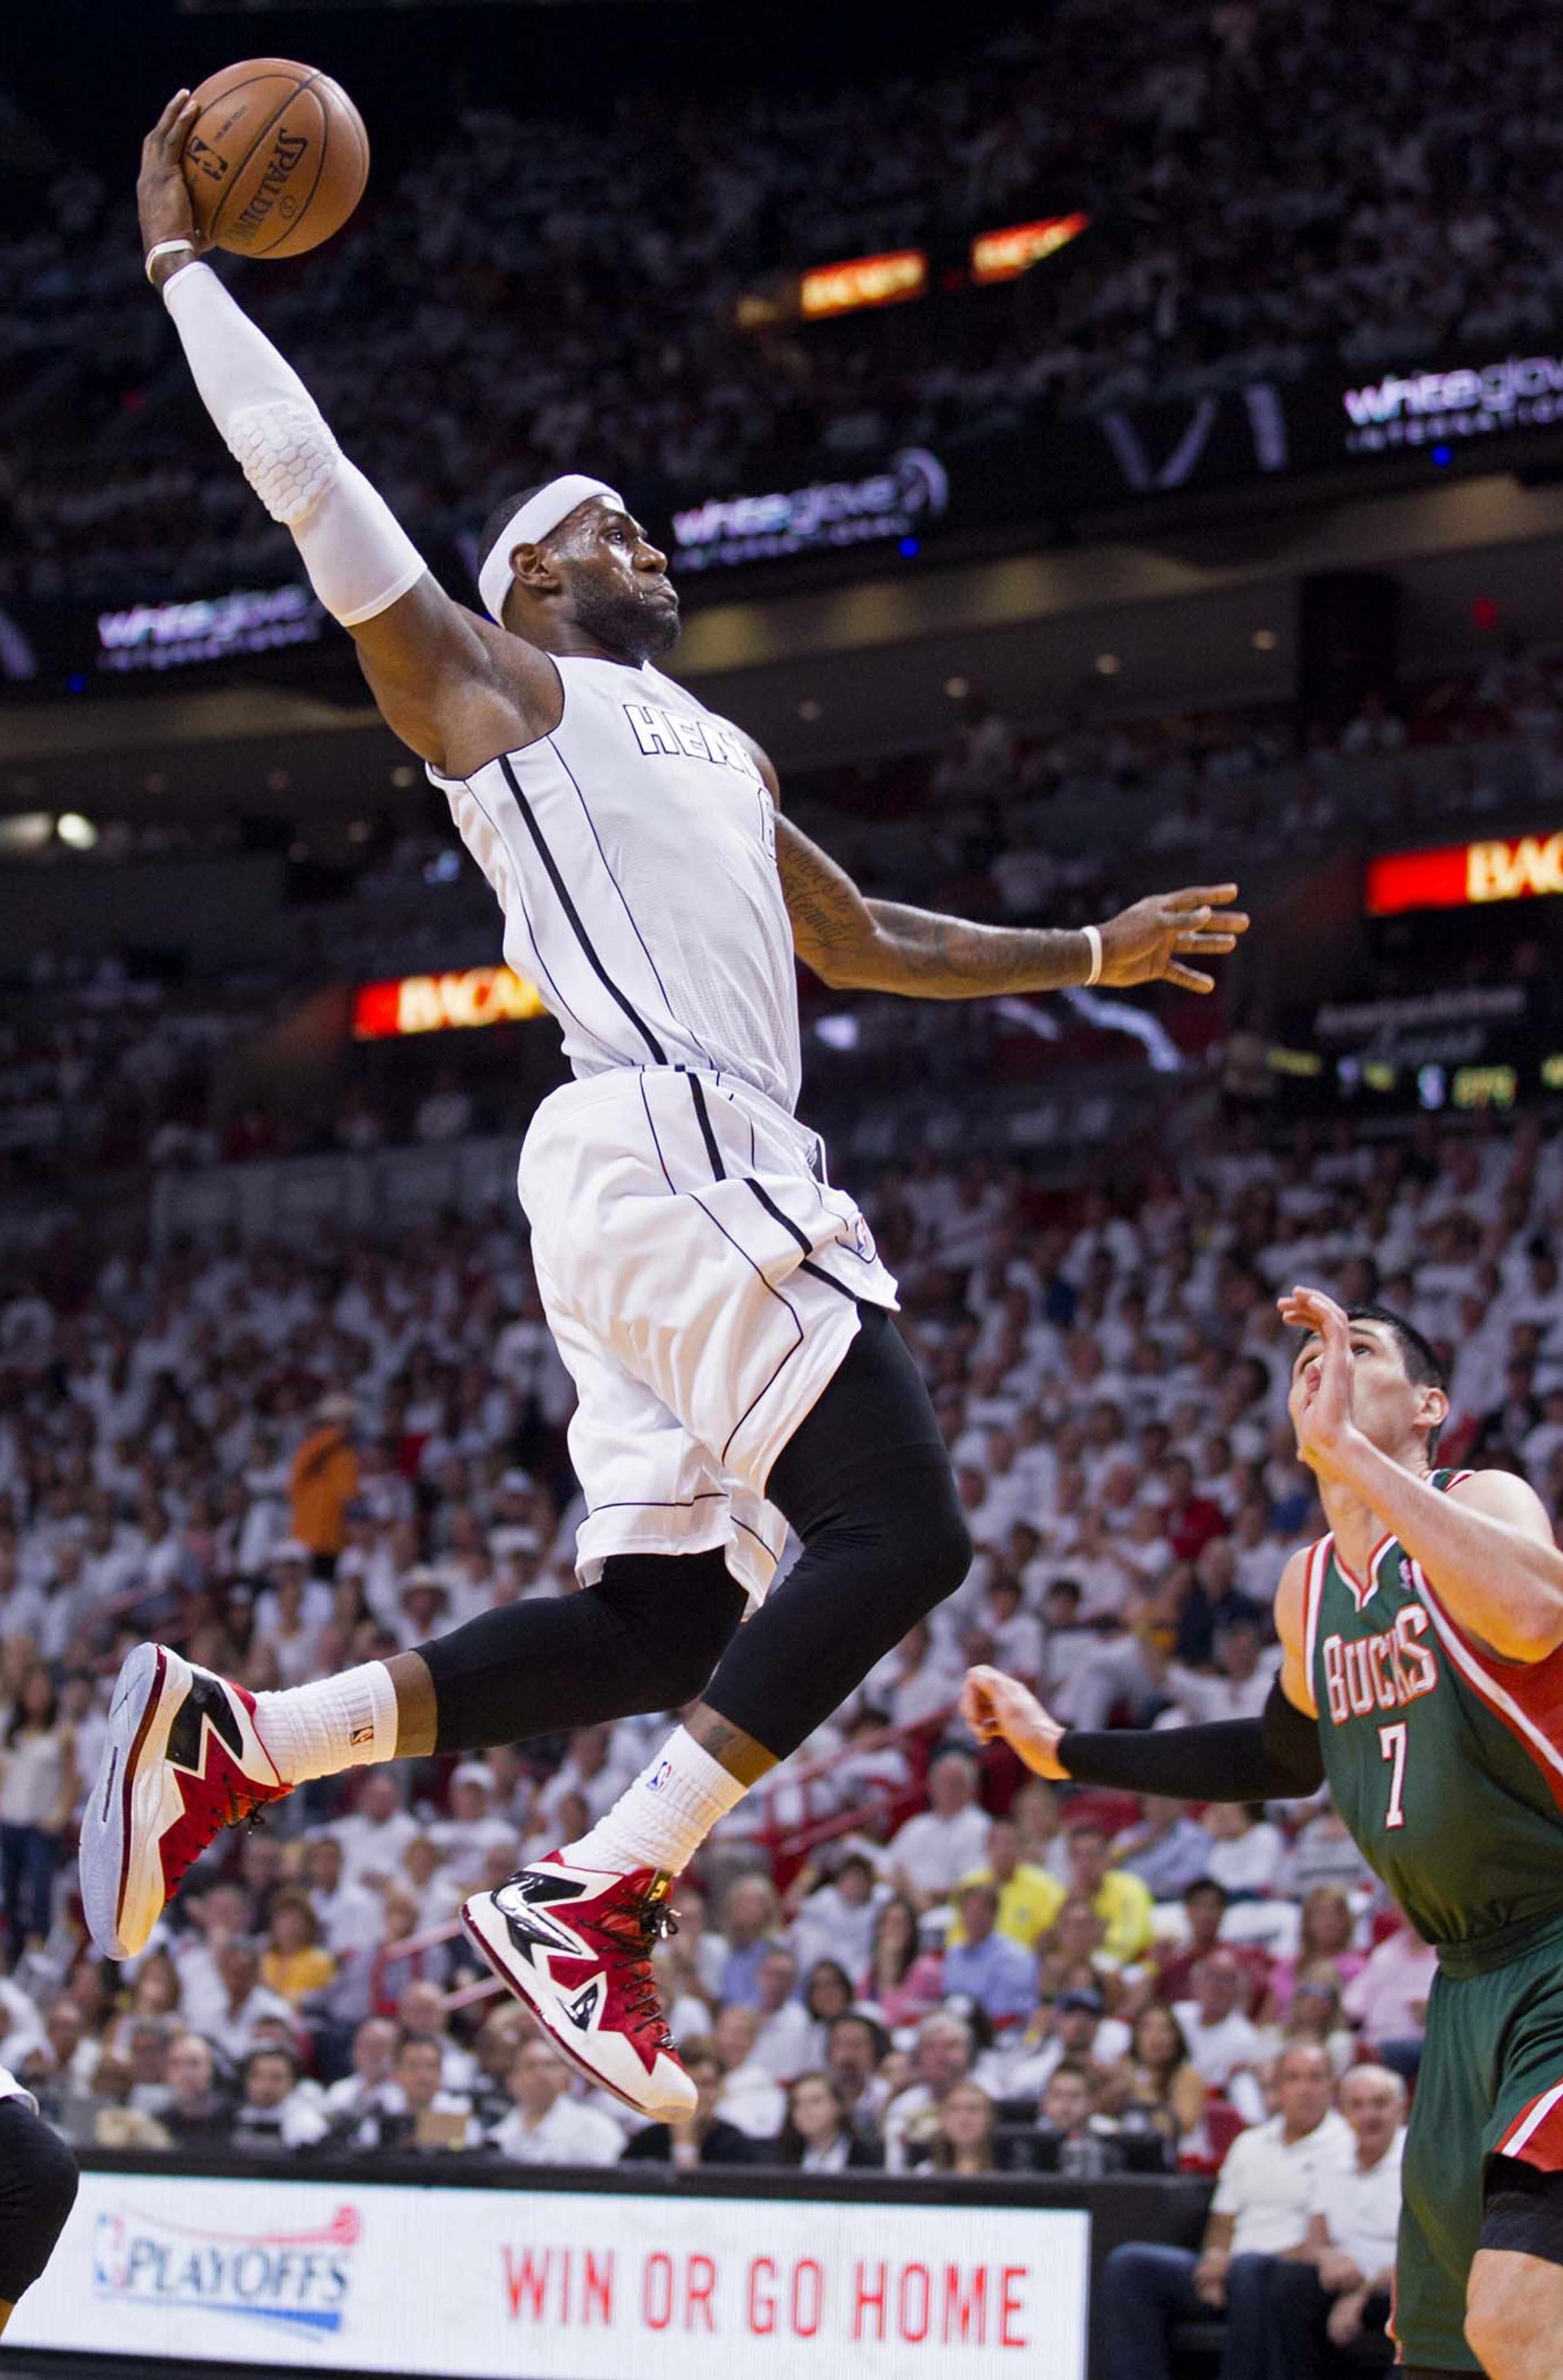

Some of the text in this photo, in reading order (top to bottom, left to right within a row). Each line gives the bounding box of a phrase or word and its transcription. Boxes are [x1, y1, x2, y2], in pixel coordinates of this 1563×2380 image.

[1322, 1602, 1438, 1727] BUCKS
[1378, 1722, 1408, 1830] 7
[127, 2237, 349, 2303] PLAYOFFS
[502, 2245, 1028, 2347] WIN OR GO HOME
